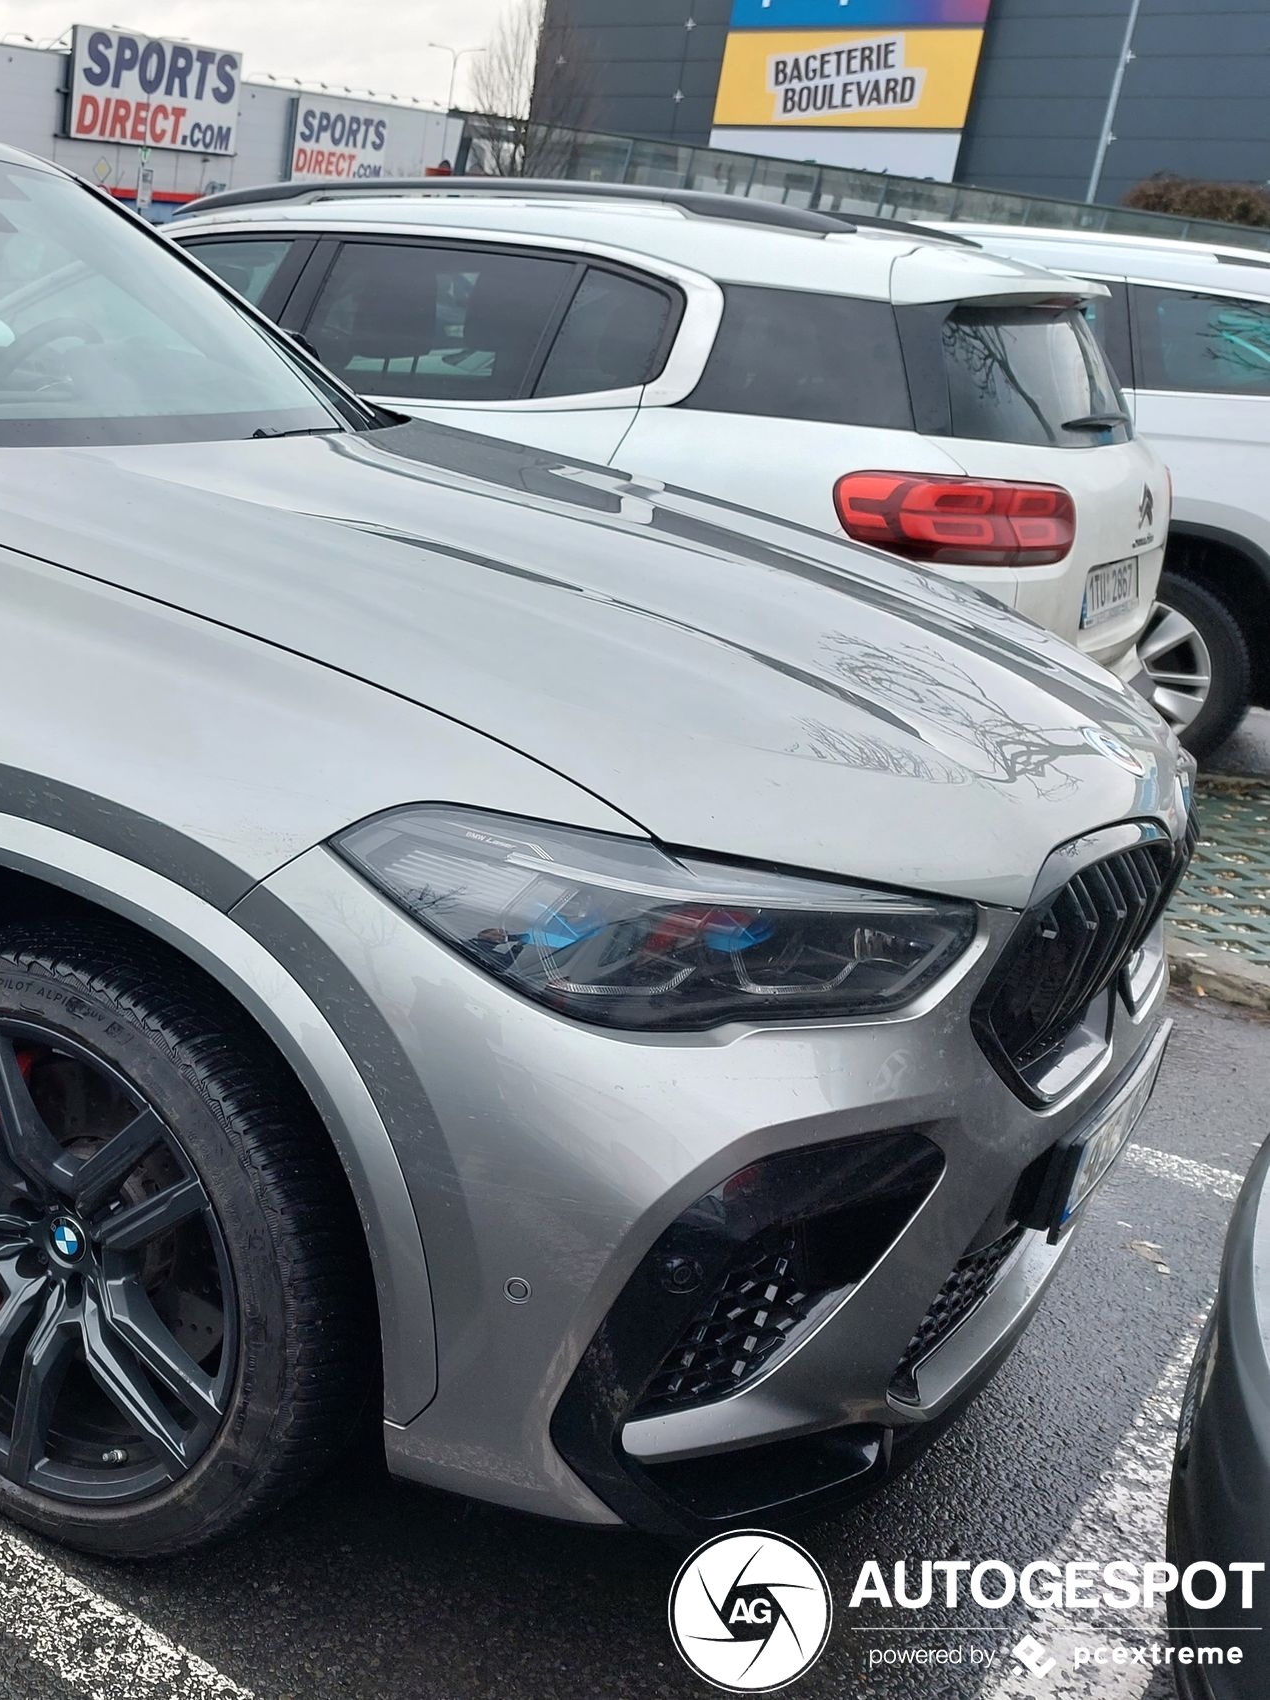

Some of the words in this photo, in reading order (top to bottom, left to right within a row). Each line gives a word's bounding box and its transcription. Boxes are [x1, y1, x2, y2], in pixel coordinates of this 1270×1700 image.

[83, 31, 238, 104] SPORTS
[774, 42, 897, 86] BAGETERIE
[783, 76, 915, 114] BOULEVARD
[76, 94, 232, 151] DIRECT.COM
[300, 109, 387, 151] SPORTS
[294, 148, 382, 178] DIRECT.COM
